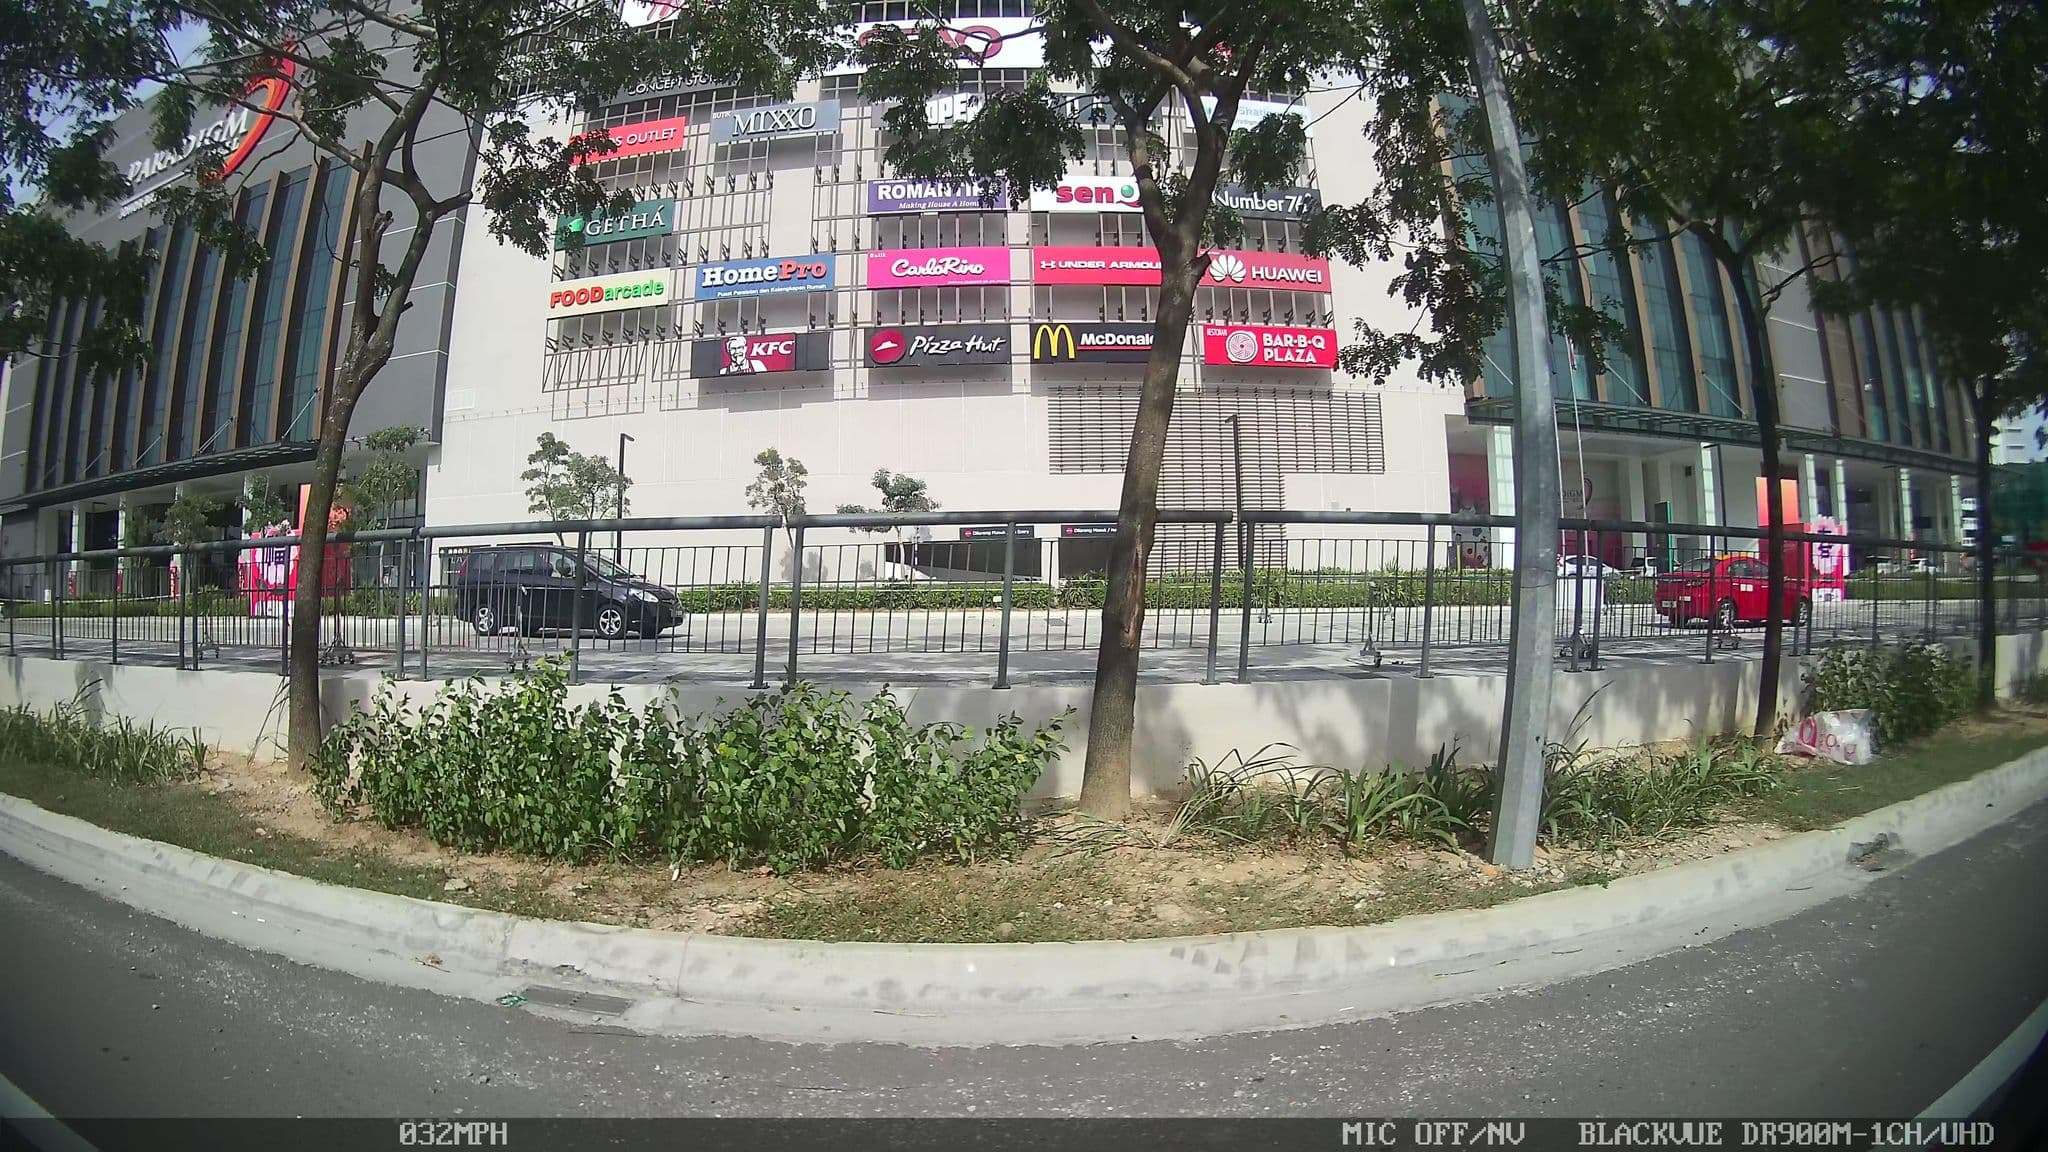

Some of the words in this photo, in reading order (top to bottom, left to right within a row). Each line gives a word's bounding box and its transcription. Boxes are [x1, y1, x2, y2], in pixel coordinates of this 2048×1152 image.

[732, 106, 817, 136] MIXXO
[626, 128, 677, 147] OUTLET
[899, 201, 926, 209] Making
[927, 200, 951, 208] House
[701, 259, 827, 289] HomePro
[1059, 260, 1106, 269] UNDER
[1109, 260, 1162, 270] ARMOU
[1251, 265, 1323, 283] HUAWEI
[750, 340, 795, 357] KFC
[909, 334, 964, 356] Pizza
[1263, 348, 1317, 363] PLAZA
